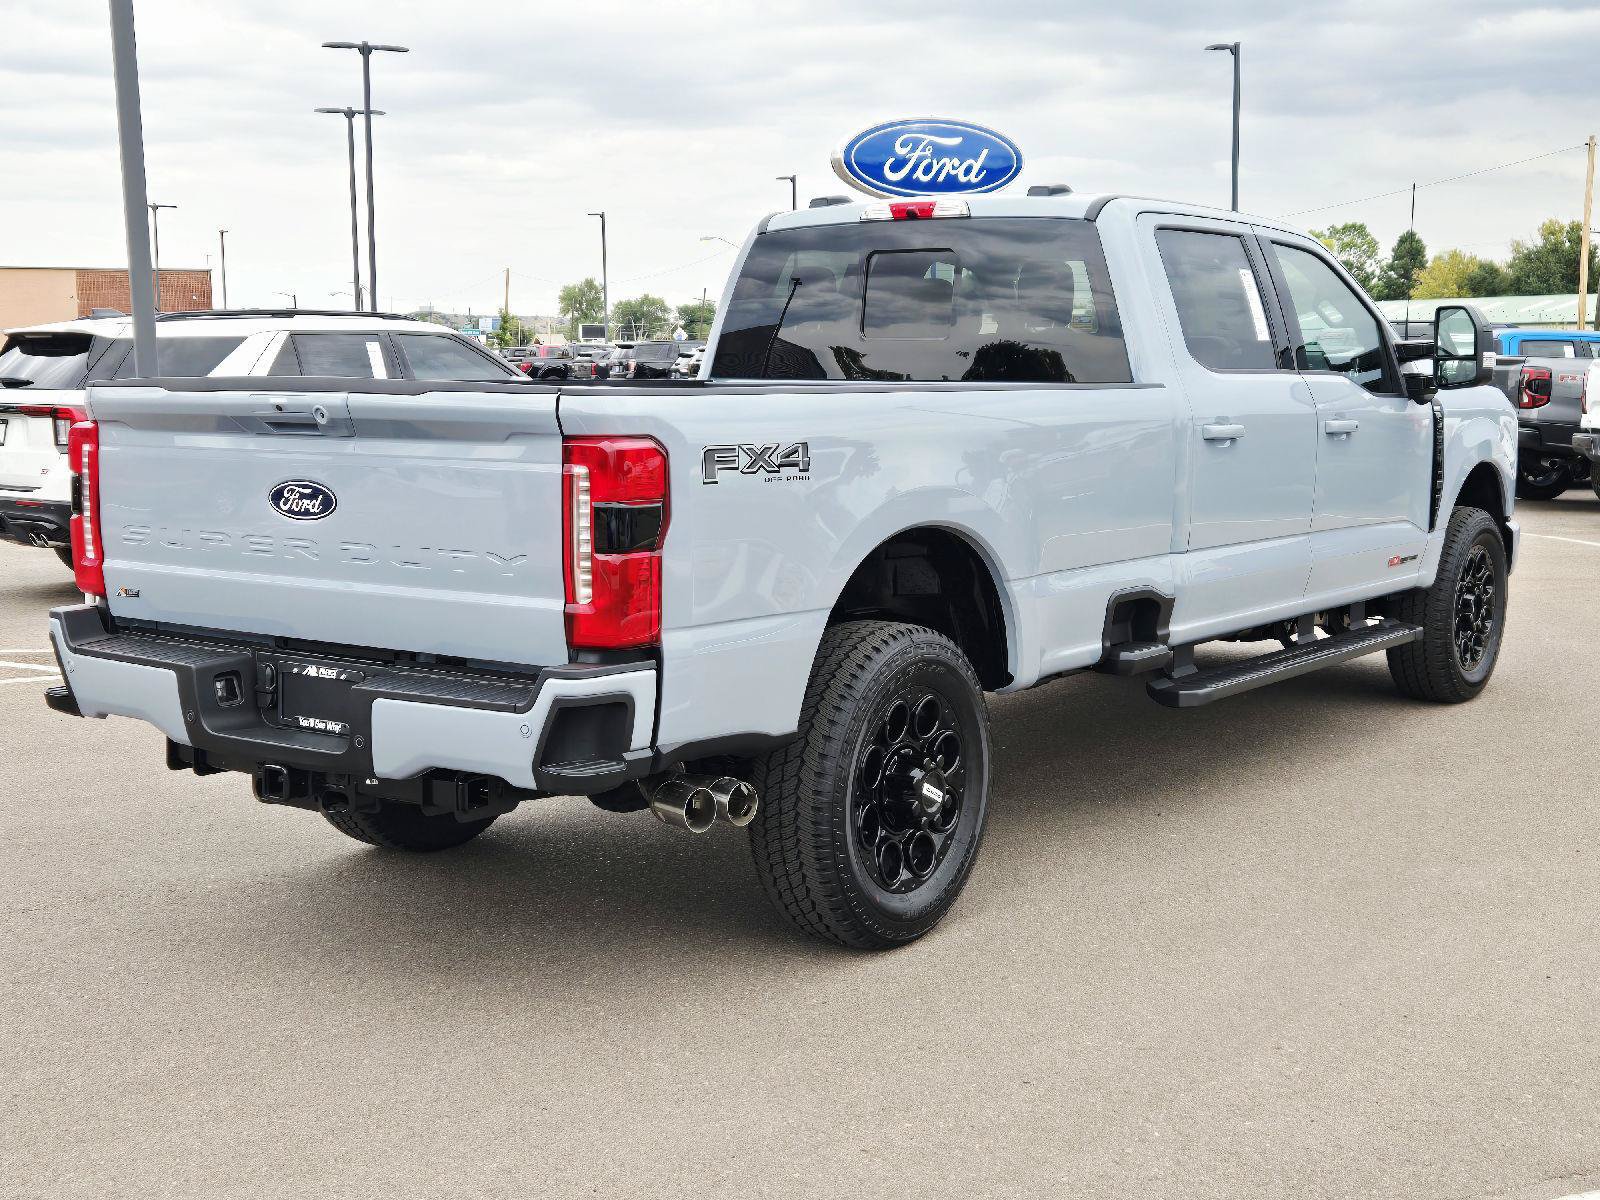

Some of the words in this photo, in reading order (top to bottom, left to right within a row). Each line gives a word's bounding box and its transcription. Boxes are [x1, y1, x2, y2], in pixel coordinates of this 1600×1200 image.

[884, 133, 989, 183] Ford
[702, 442, 811, 485] FX4
[280, 486, 323, 513] Ford
[121, 524, 320, 561] SUPER
[339, 541, 528, 577] DUTY
